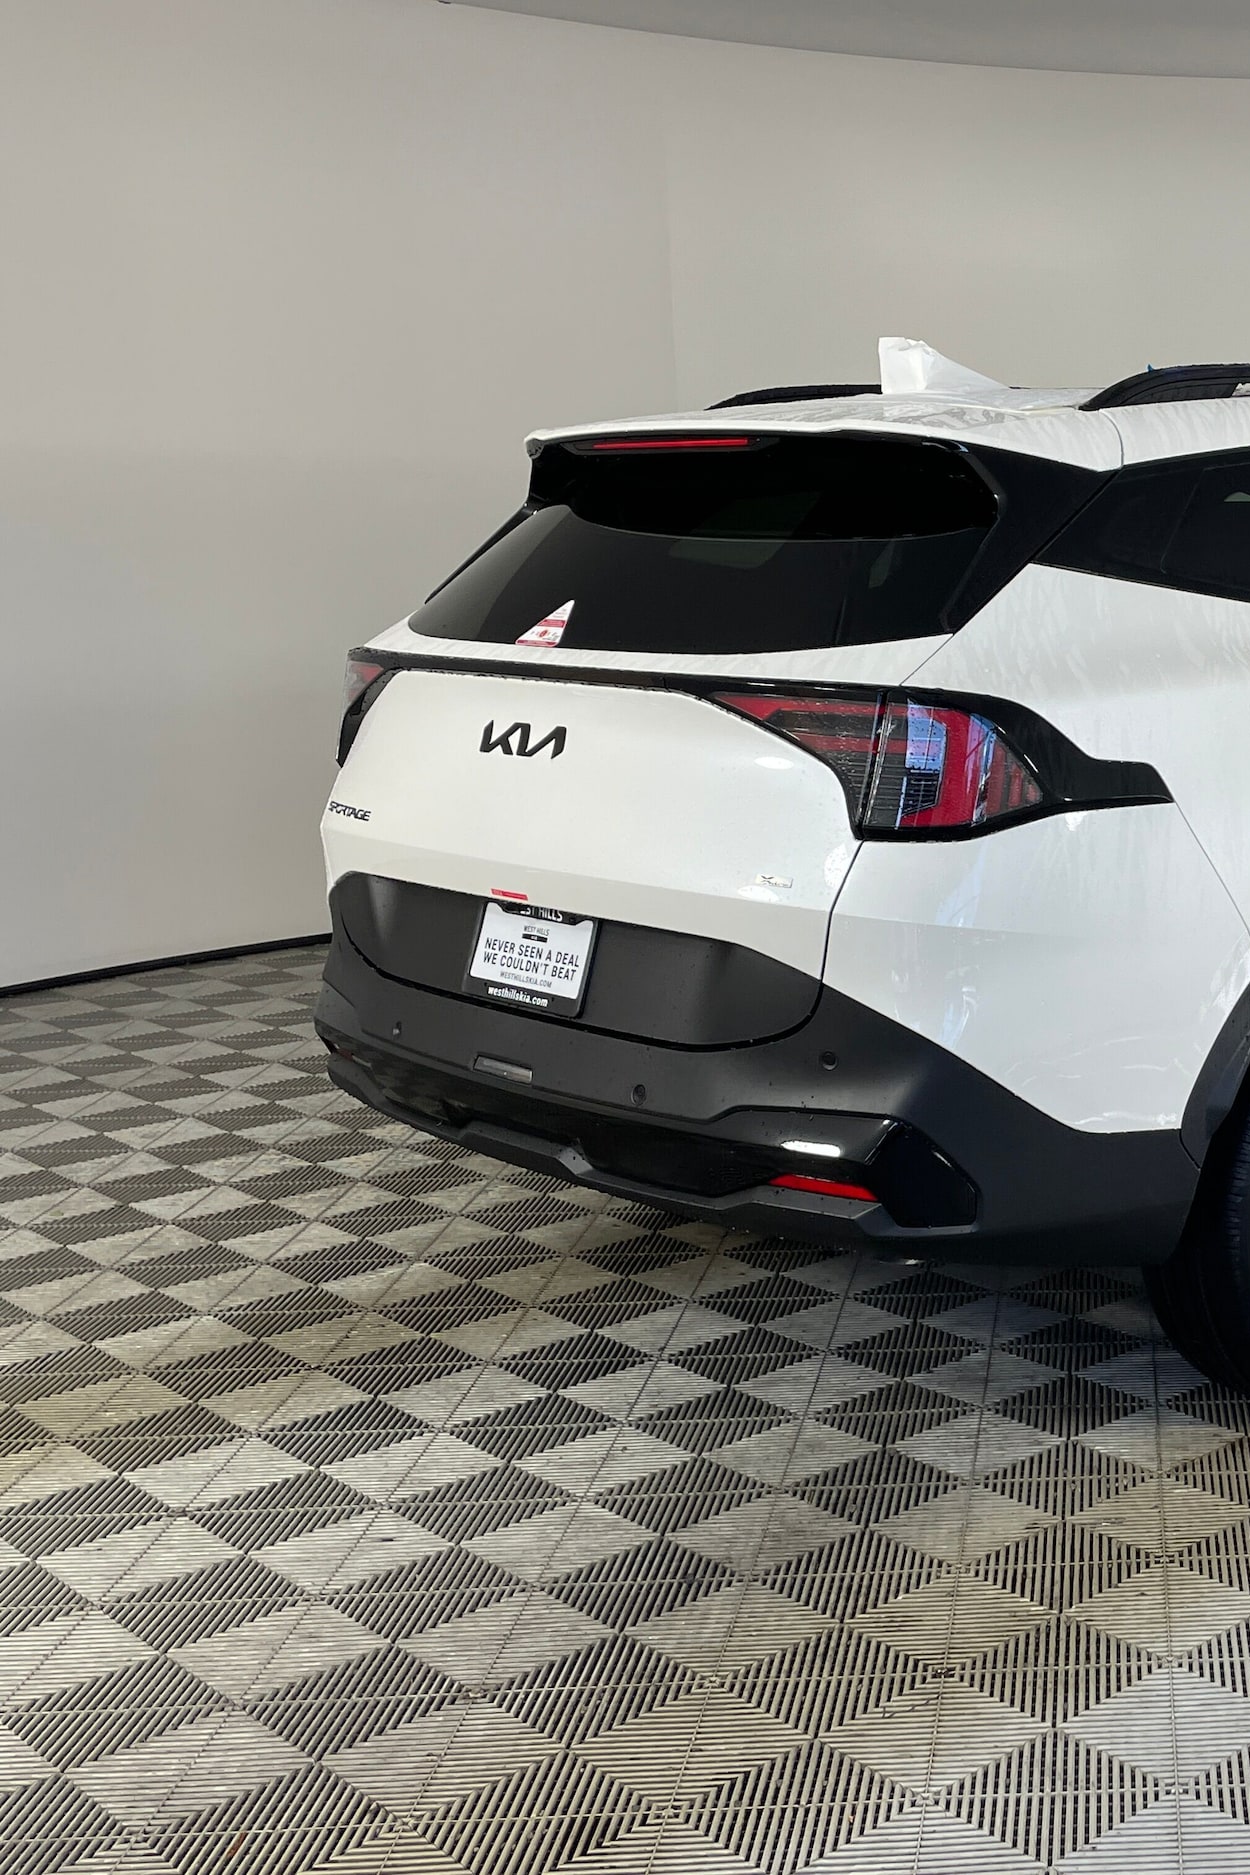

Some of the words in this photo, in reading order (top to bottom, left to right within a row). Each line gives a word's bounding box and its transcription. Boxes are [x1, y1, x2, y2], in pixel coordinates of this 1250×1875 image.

[523, 925, 536, 933] WEST
[537, 927, 550, 937] HILLS
[484, 937, 516, 954] NEVER
[518, 944, 543, 960] SEEN
[545, 949, 552, 962] A
[555, 951, 579, 968] DEAL
[483, 951, 497, 965] WE
[500, 954, 549, 976] COULDN'T
[551, 965, 577, 981] BEAT
[500, 971, 553, 988] WESTHILLSKIA.COM
[487, 985, 549, 1008] westhillskia.com
